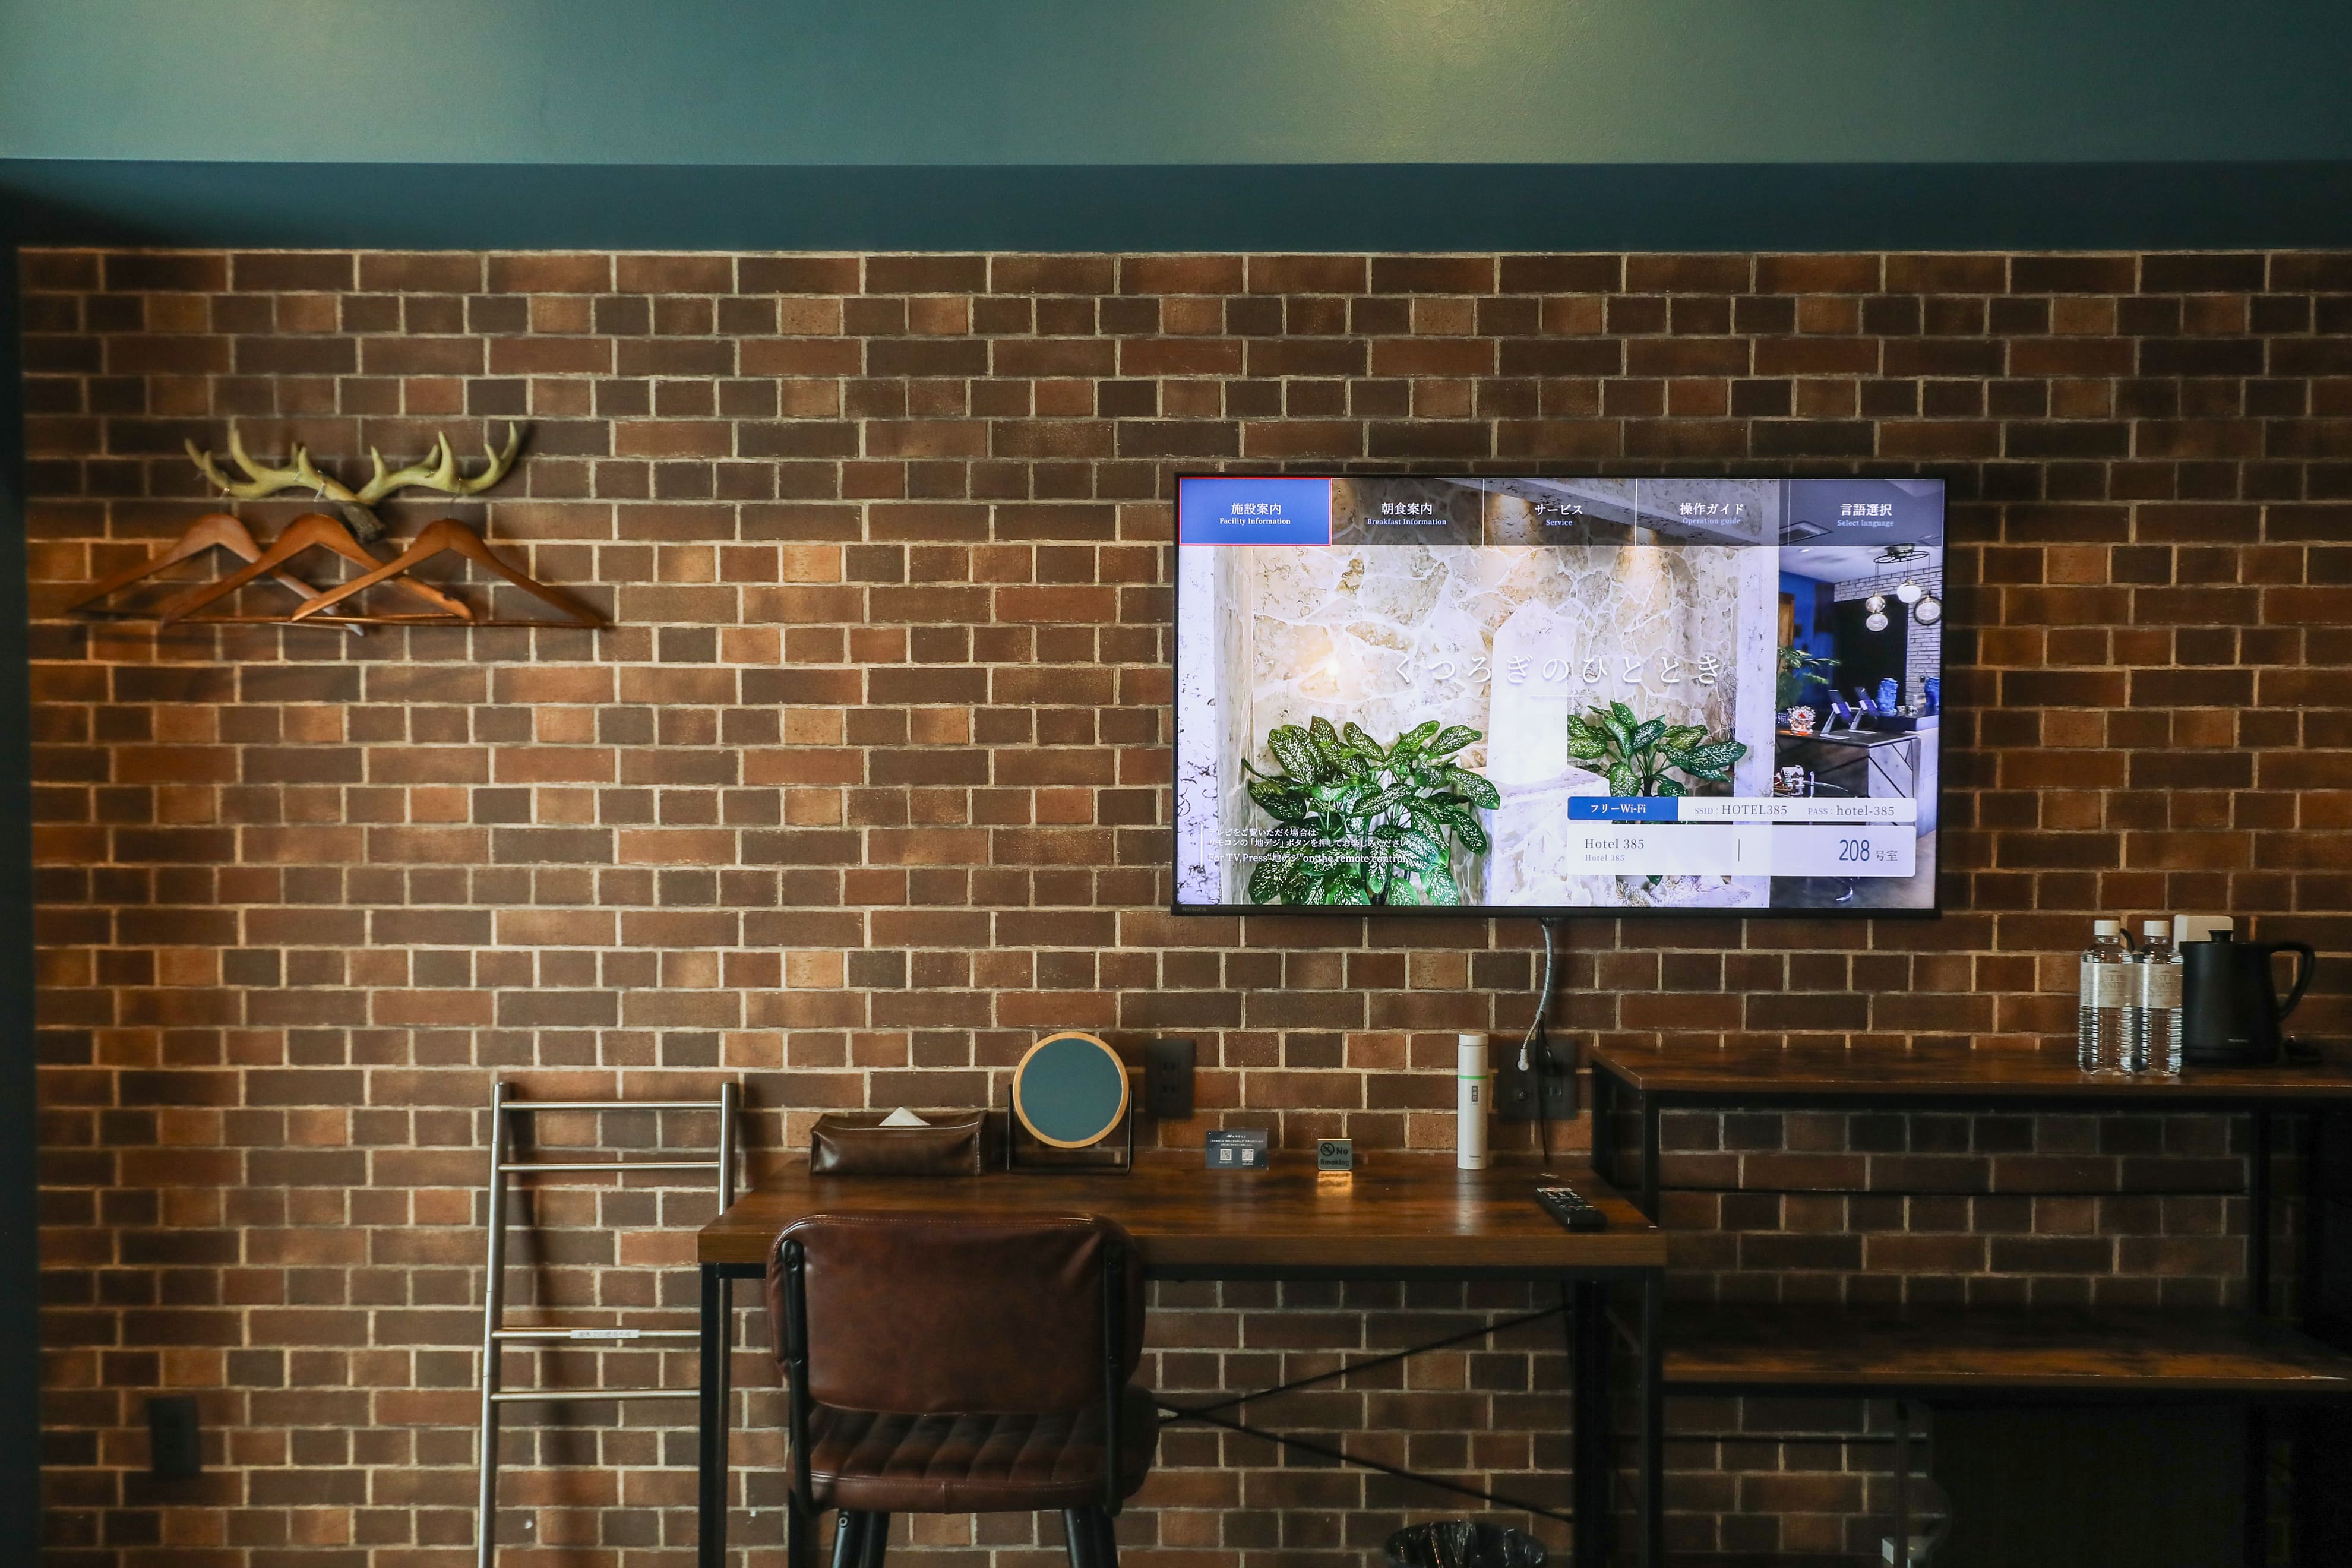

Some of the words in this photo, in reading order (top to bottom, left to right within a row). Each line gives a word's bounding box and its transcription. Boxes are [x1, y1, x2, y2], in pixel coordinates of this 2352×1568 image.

[1231, 502, 1282, 516] 施設案内
[1381, 502, 1433, 516] 朝食案内
[1534, 503, 1583, 516] サービス
[1680, 502, 1744, 516] 操作ガイド
[1840, 503, 1892, 517] 言語選択
[1219, 517, 1245, 527] Facility
[1248, 517, 1291, 526] Information
[1367, 517, 1401, 526] Breakfast
[1403, 517, 1447, 526] Information
[1545, 518, 1573, 527] Service
[1683, 517, 1719, 526] Operation
[1721, 517, 1741, 527] guide
[1837, 519, 1858, 527] Select
[1860, 519, 1894, 529] language
[1395, 655, 1720, 685] くつろぎのひととき
[1590, 802, 1646, 814] フリーWi-Fi
[1721, 804, 1788, 815] HOTEL385
[1836, 805, 1895, 816] hotel-385
[1584, 838, 1619, 849] Hotel
[1623, 838, 1645, 850] 385
[1838, 839, 1870, 862] 208
[1874, 849, 1898, 862] 号室
[1209, 853, 1224, 862] For
[1336, 1147, 1349, 1155] No
[1320, 1158, 1349, 1167] Smoking
